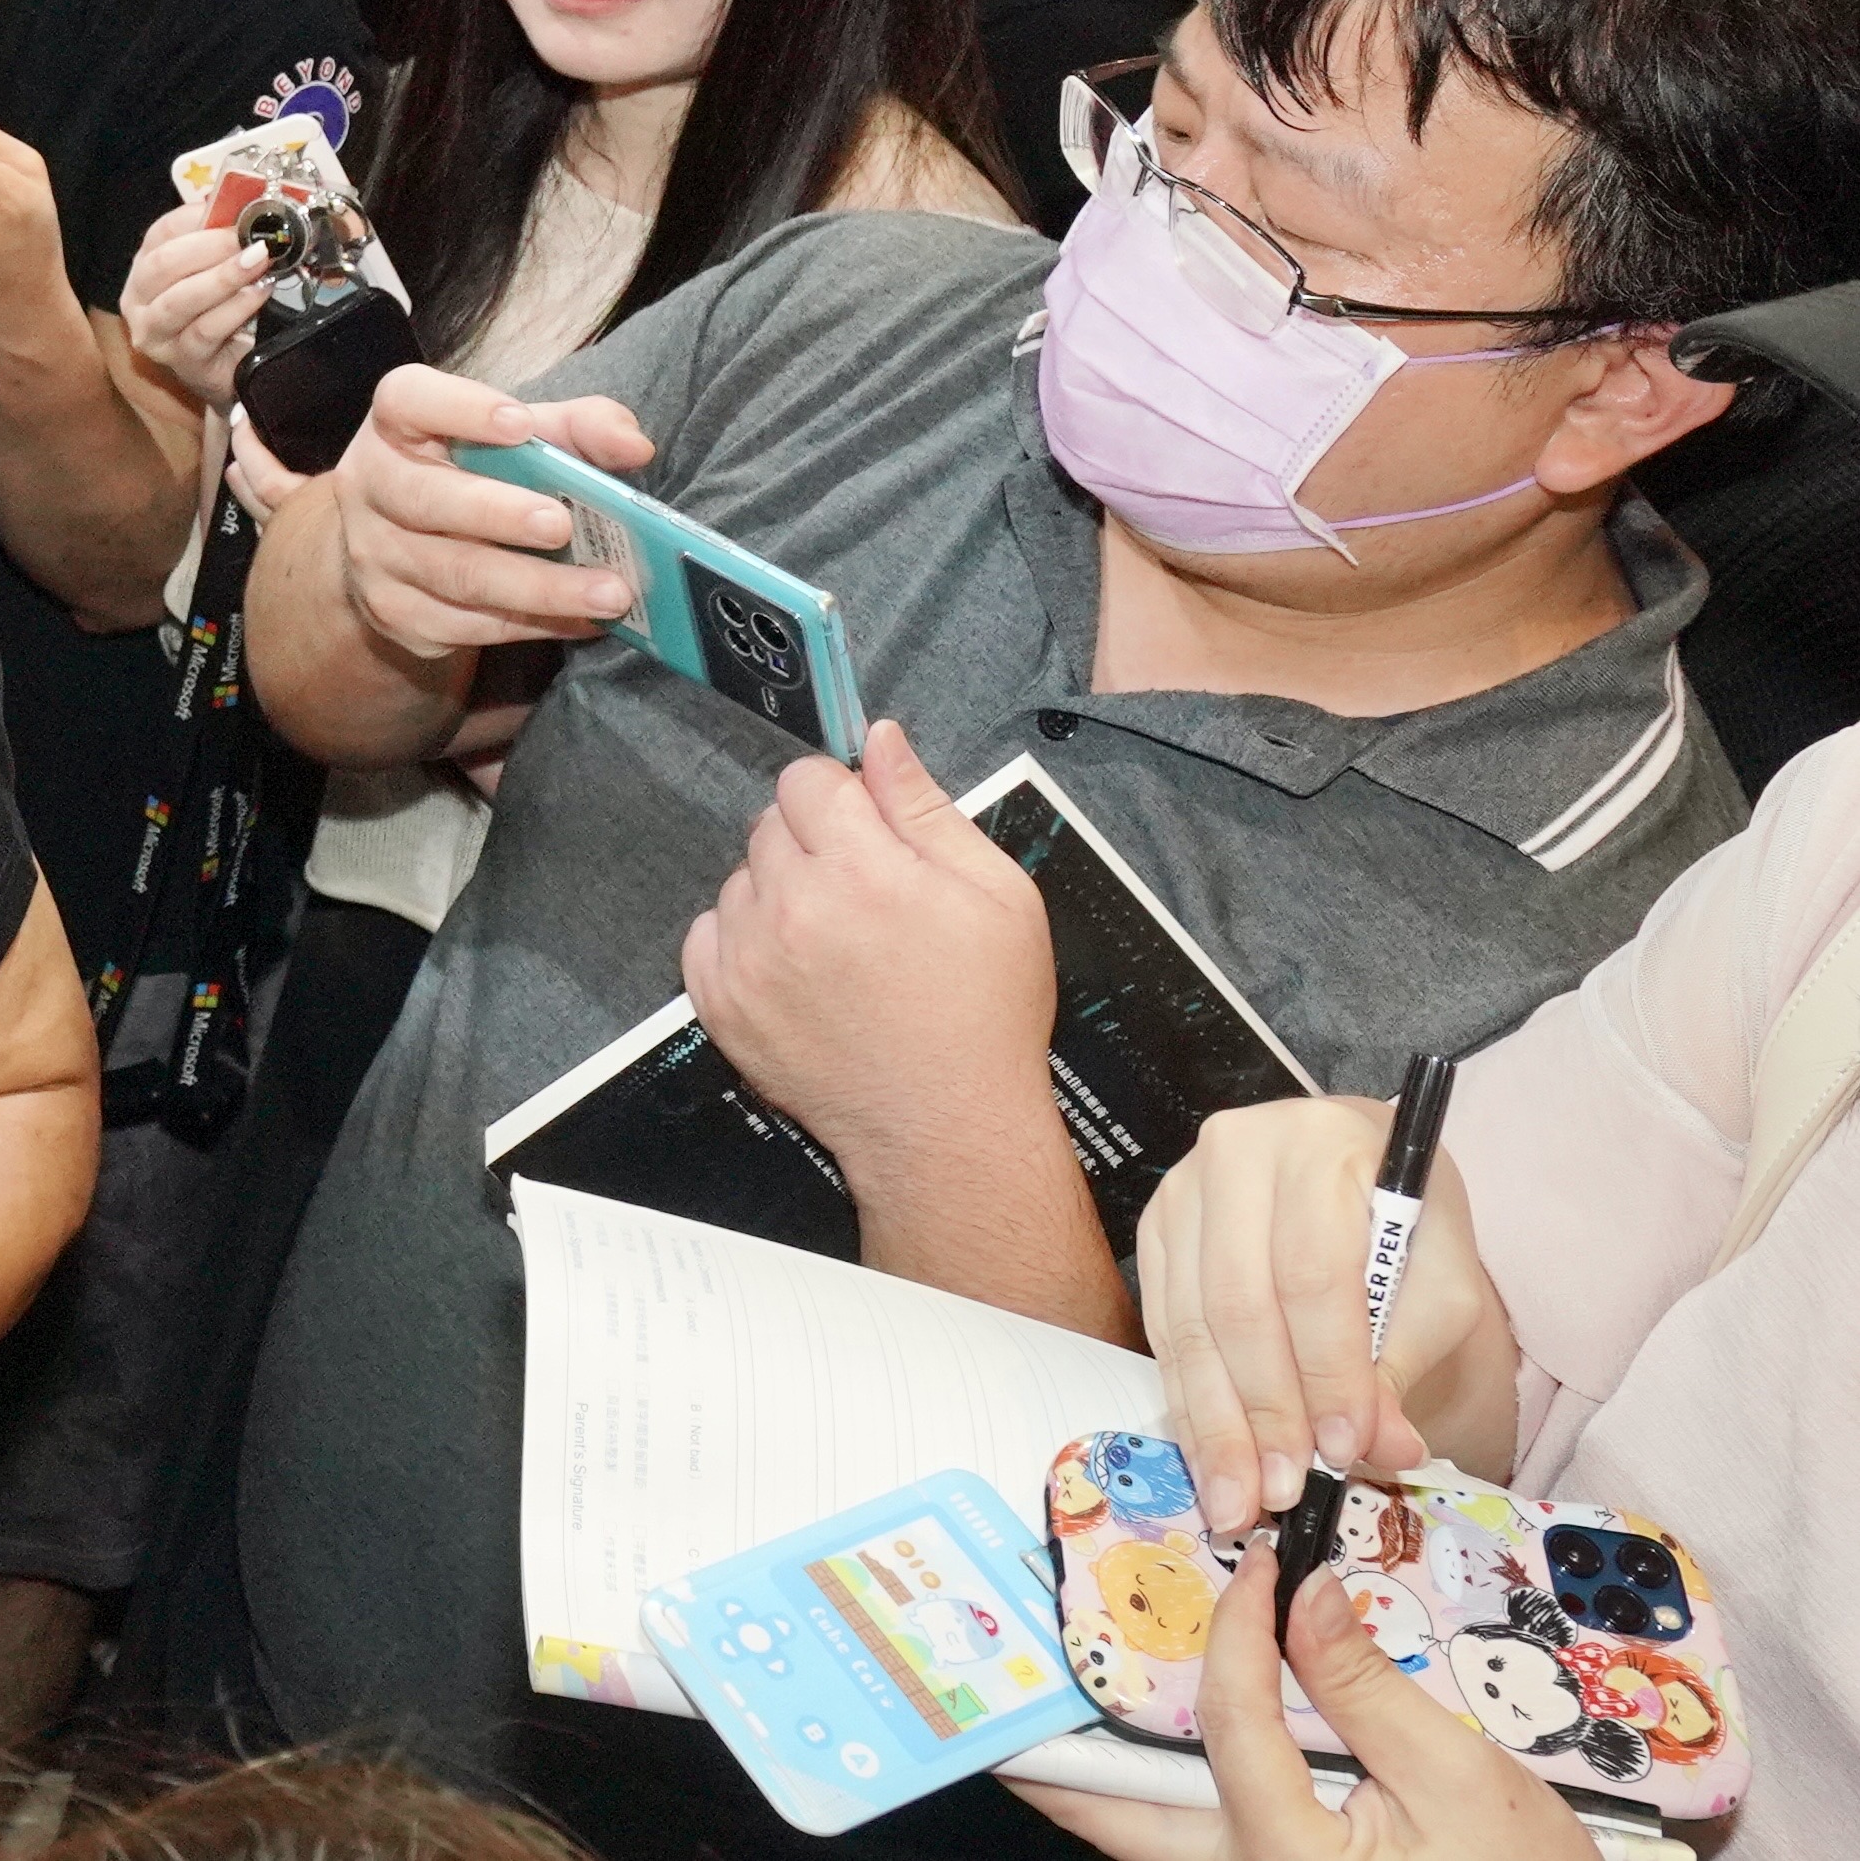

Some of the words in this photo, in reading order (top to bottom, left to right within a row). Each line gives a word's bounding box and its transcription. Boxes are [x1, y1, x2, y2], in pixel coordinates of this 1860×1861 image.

[253, 56, 362, 119] BEYOND
[175, 642, 208, 721] Microsoft
[179, 1011, 212, 1087] Microsoft
[1375, 1220, 1404, 1266] PEN
[573, 1402, 589, 1460] Parent's
[808, 1606, 850, 1655] Cube
